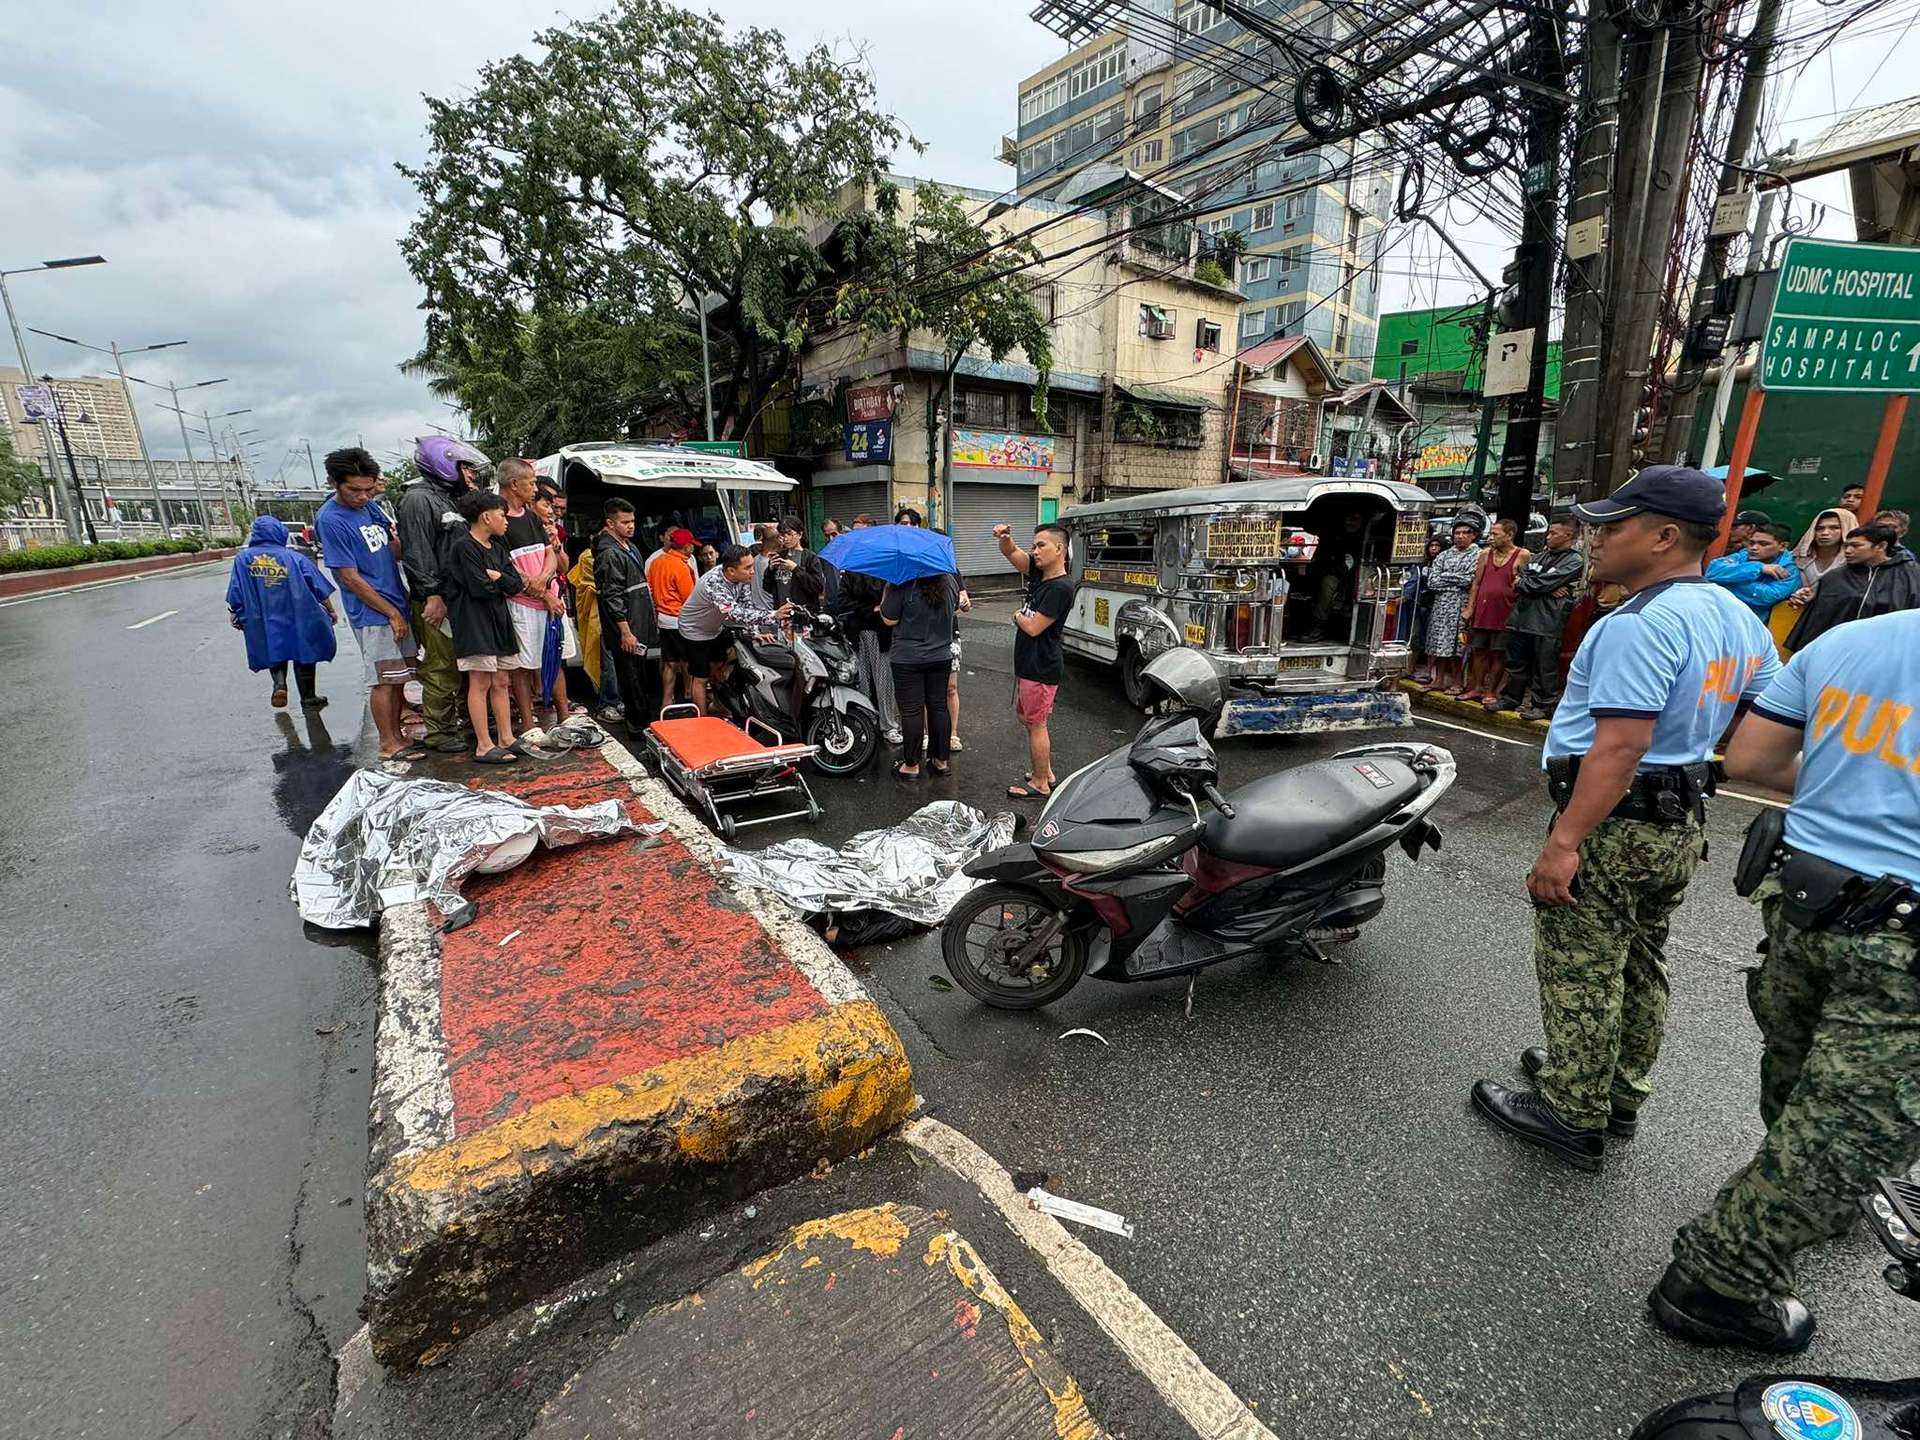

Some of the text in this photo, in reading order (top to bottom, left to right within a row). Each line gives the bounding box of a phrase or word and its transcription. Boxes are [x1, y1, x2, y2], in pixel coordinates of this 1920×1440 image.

[1786, 265, 1913, 299] UDMC HOSPITAL
[1772, 325, 1901, 351] SAMPALOC
[1766, 356, 1890, 381] HOSPITAL
[851, 431, 868, 452] 24
[637, 467, 761, 477] EMERGENCY
